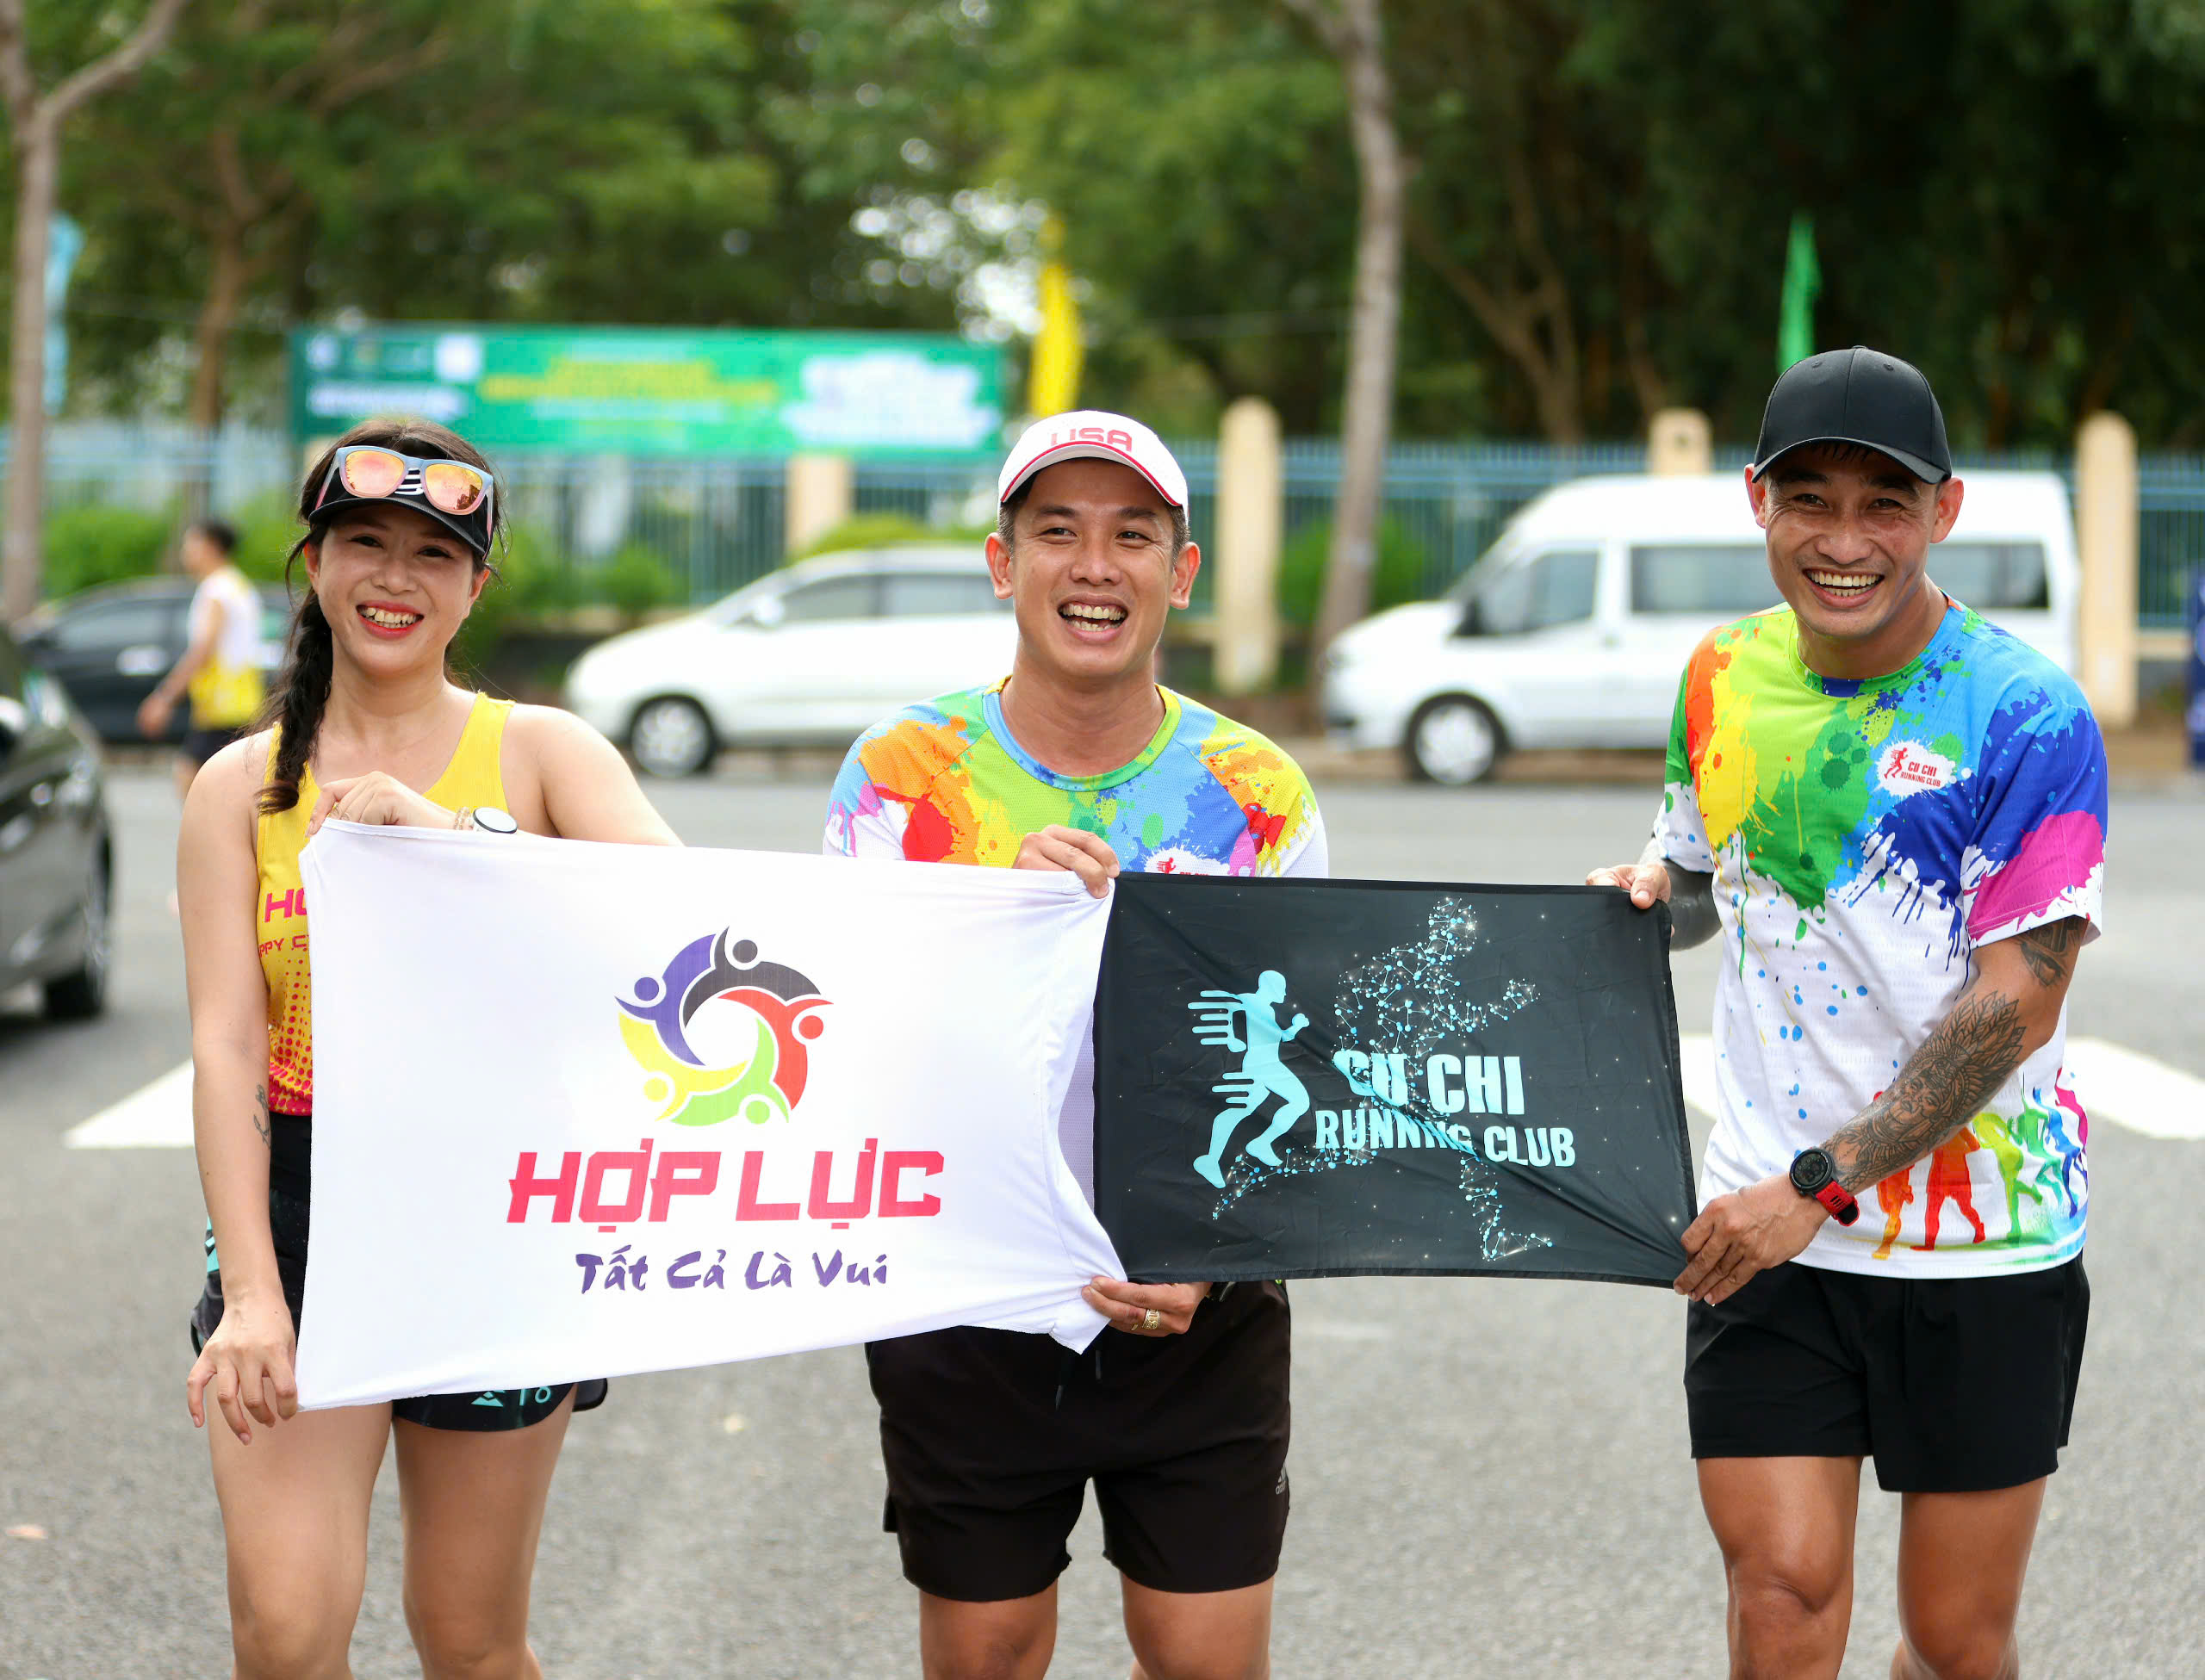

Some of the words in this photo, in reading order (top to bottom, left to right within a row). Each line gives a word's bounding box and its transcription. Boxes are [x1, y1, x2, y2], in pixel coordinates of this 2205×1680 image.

[1051, 427, 1133, 453] USA
[1901, 772, 1926, 784] RUNNING
[1926, 778, 1941, 787] CLUB
[1908, 761, 1920, 772] CU
[1922, 765, 1937, 777] CHI
[258, 938, 284, 958] PPY
[1332, 1050, 1408, 1107] CU
[1426, 1053, 1525, 1115] CHI
[1315, 1110, 1477, 1156] RUNNING
[1483, 1126, 1576, 1168] CLUB
[506, 1138, 722, 1233] HỢP
[735, 1138, 945, 1230] LỰC
[575, 1244, 649, 1294] Tất
[666, 1249, 727, 1290] Cả
[743, 1251, 792, 1290] Là
